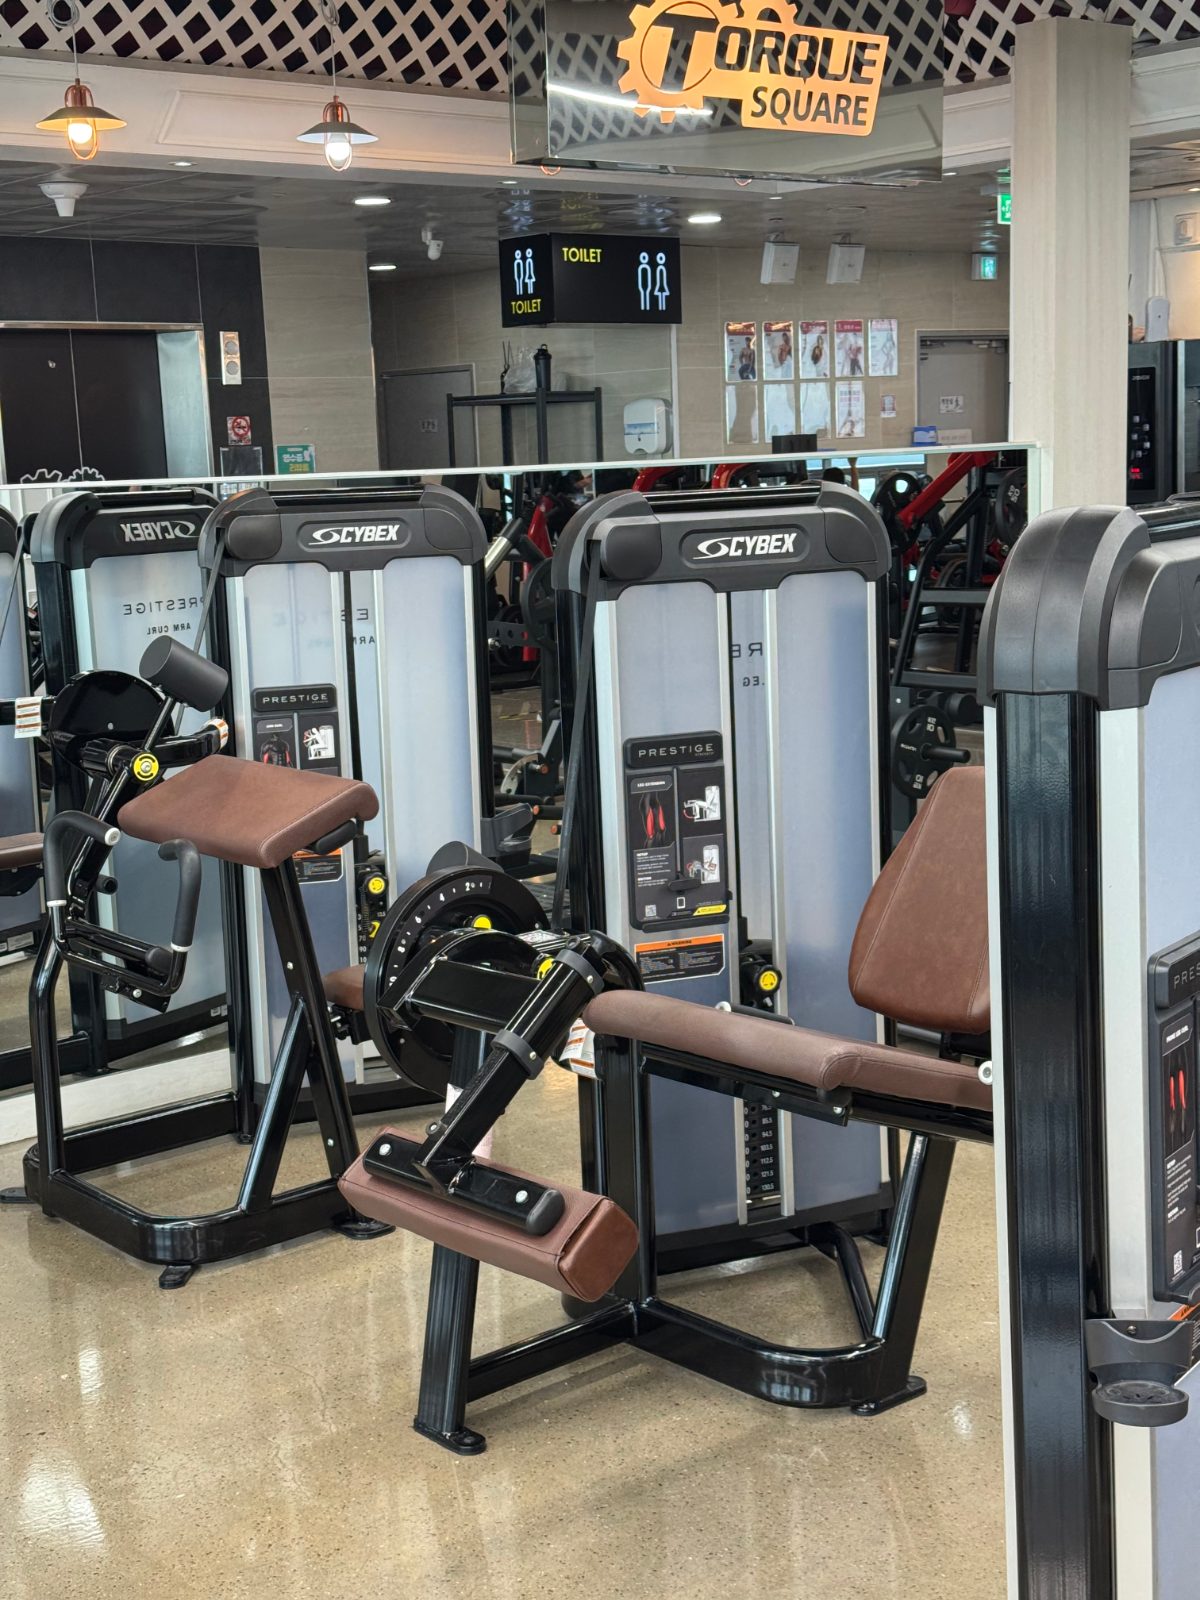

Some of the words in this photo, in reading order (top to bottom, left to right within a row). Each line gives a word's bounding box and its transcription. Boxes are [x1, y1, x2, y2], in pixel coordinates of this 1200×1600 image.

[651, 12, 881, 92] TORQUE
[750, 85, 869, 126] SQUARE
[561, 247, 602, 263] TOILET
[510, 298, 542, 315] TOILET
[339, 524, 400, 544] CYBEX
[728, 532, 797, 557] CYBEX
[262, 693, 329, 705] PRESTIGE
[638, 743, 714, 758] PRESTIGE
[465, 881, 471, 891] 2
